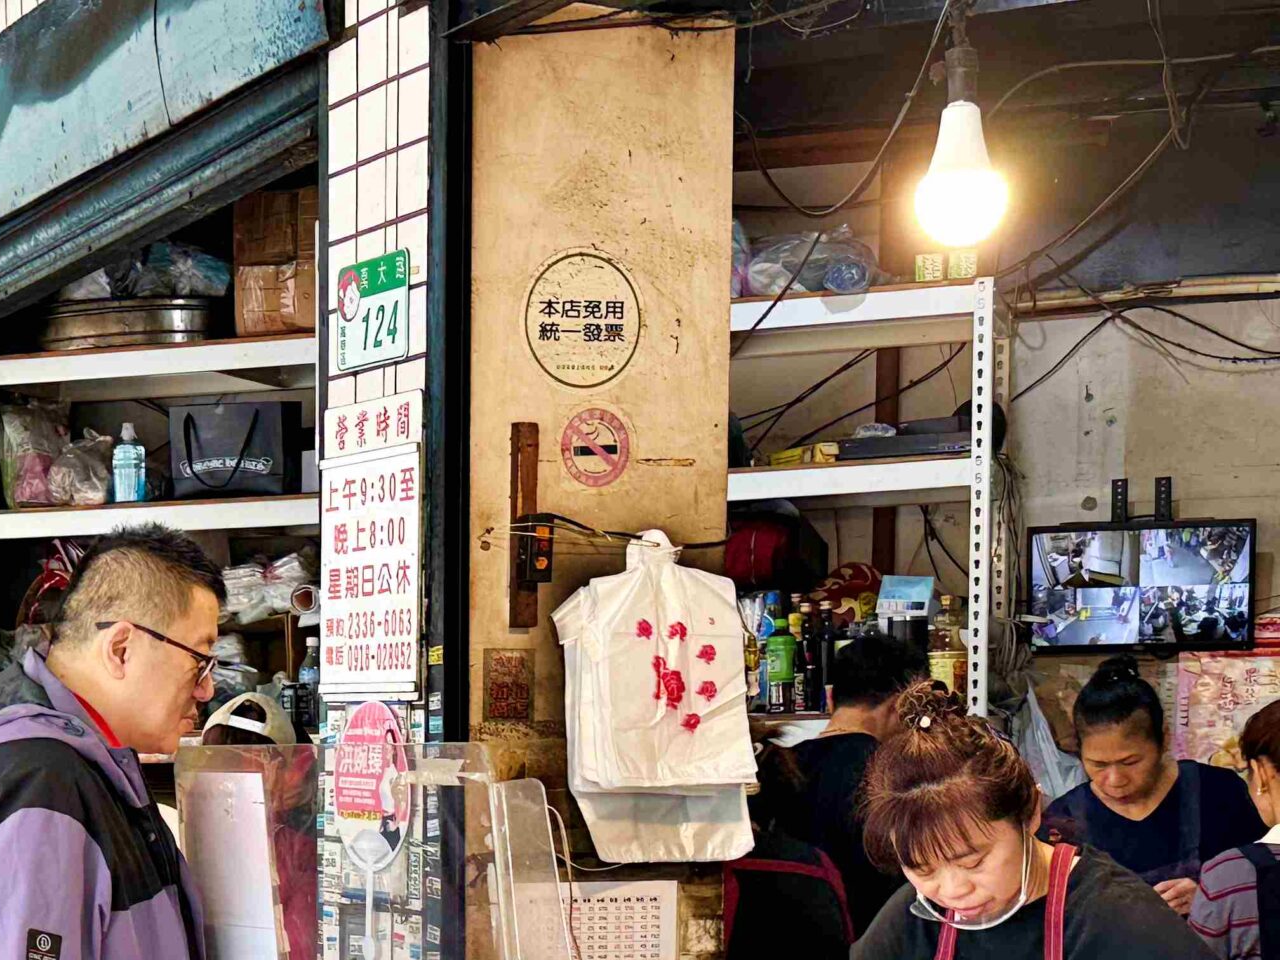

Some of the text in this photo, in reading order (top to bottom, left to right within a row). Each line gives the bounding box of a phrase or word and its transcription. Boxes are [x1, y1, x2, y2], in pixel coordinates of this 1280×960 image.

[361, 299, 399, 351] 124
[538, 299, 625, 320] 本店免用
[538, 321, 625, 342] 統一發票
[335, 401, 410, 450] 營業時間
[325, 466, 415, 513] 上午9:30至
[333, 516, 406, 555] 晚上8:00
[327, 559, 411, 600] 星期日公休
[348, 608, 412, 640] 2336-6063
